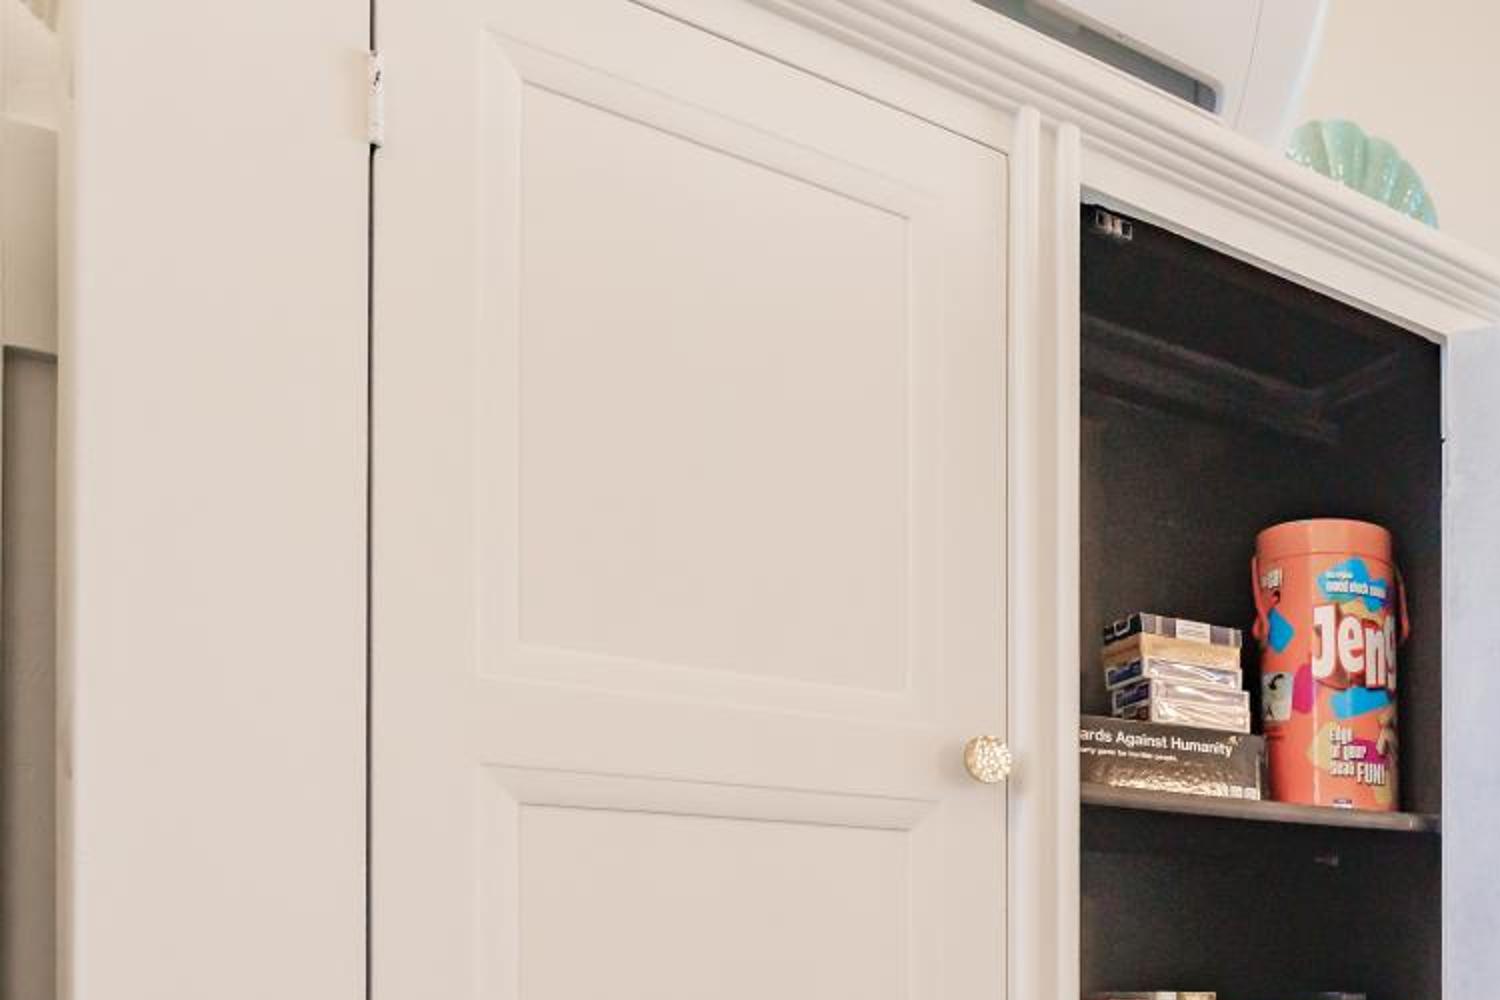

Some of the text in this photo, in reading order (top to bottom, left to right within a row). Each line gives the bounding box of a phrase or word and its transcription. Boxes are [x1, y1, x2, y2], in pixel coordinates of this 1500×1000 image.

[1311, 604, 1397, 690] Jeng
[1080, 728, 1233, 758] ards Against Humanity
